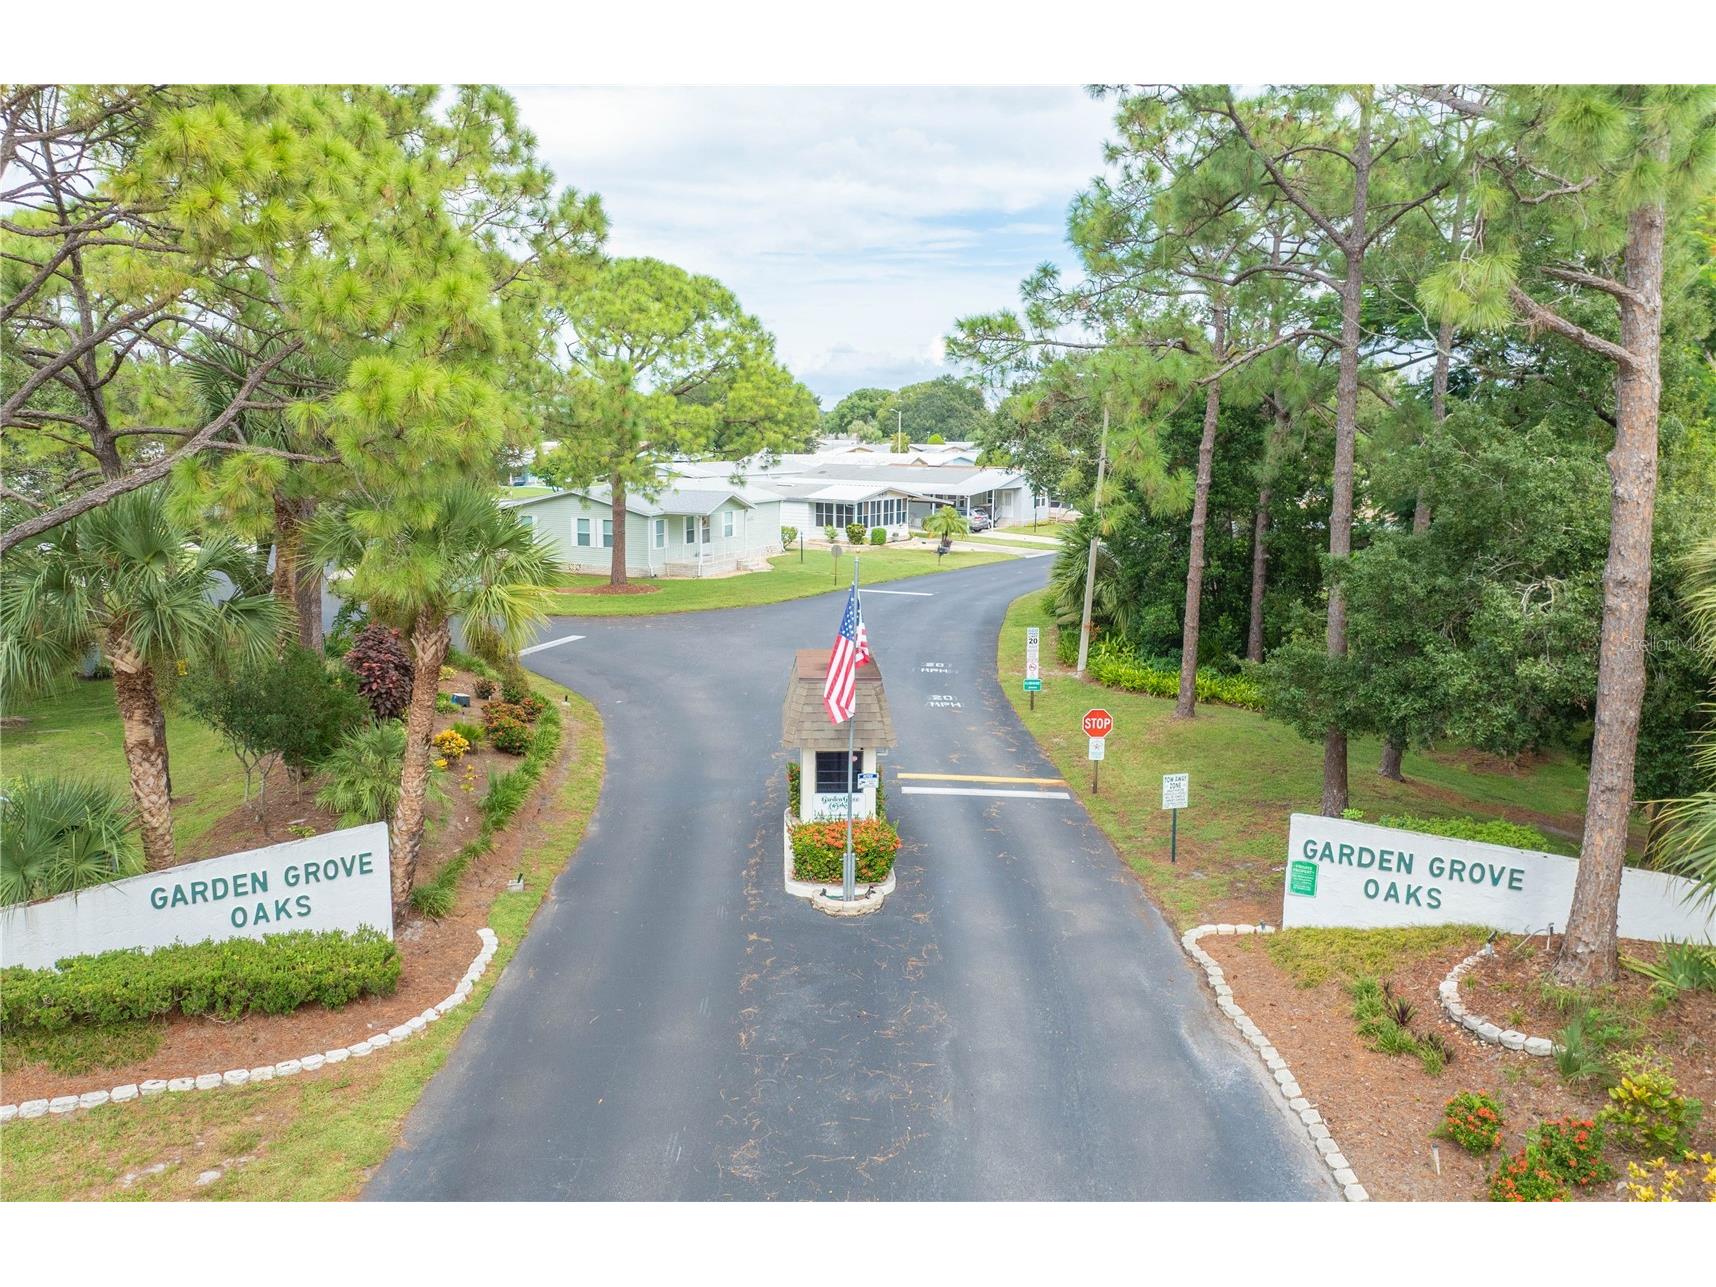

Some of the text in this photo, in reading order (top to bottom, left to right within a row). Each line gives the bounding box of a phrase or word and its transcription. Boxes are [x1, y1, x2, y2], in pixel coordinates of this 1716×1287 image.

[1029, 637, 1038, 645] 20
[1084, 717, 1111, 730] STOP
[150, 852, 374, 910] GARDEN GROVE
[1303, 839, 1525, 891] GARDEN GROVE
[1364, 878, 1442, 909] OAKS
[231, 895, 312, 928] OAKS
